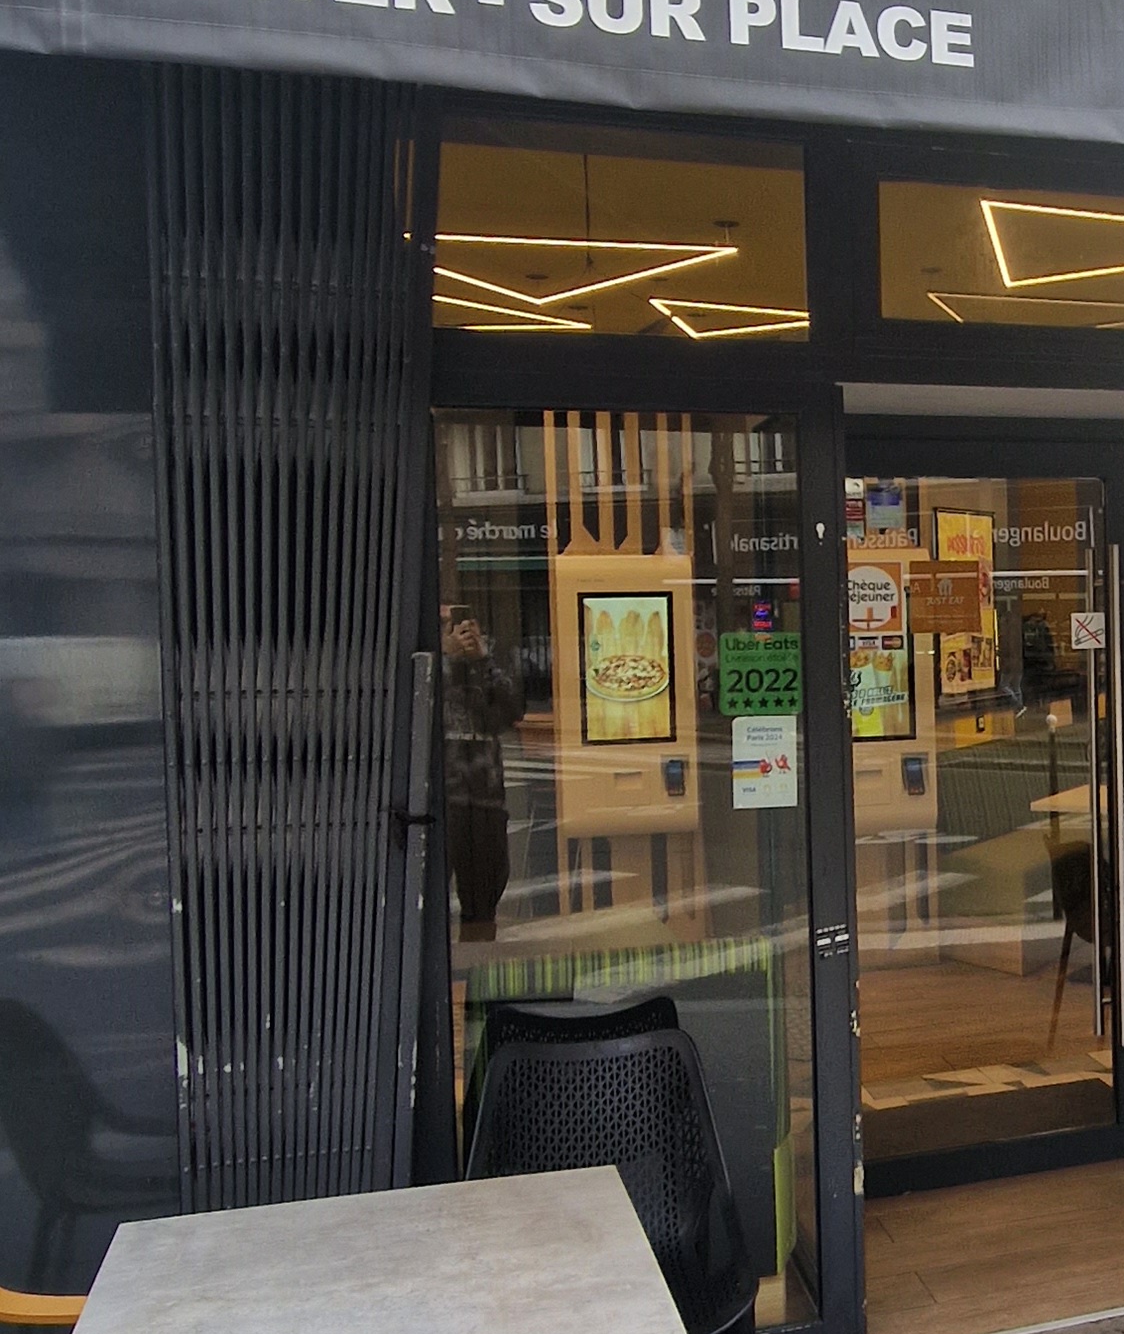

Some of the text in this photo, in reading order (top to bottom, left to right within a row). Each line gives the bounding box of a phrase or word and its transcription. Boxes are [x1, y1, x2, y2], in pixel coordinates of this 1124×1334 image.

[725, 636, 799, 652] Uber Eats
[726, 668, 799, 694] 2022
